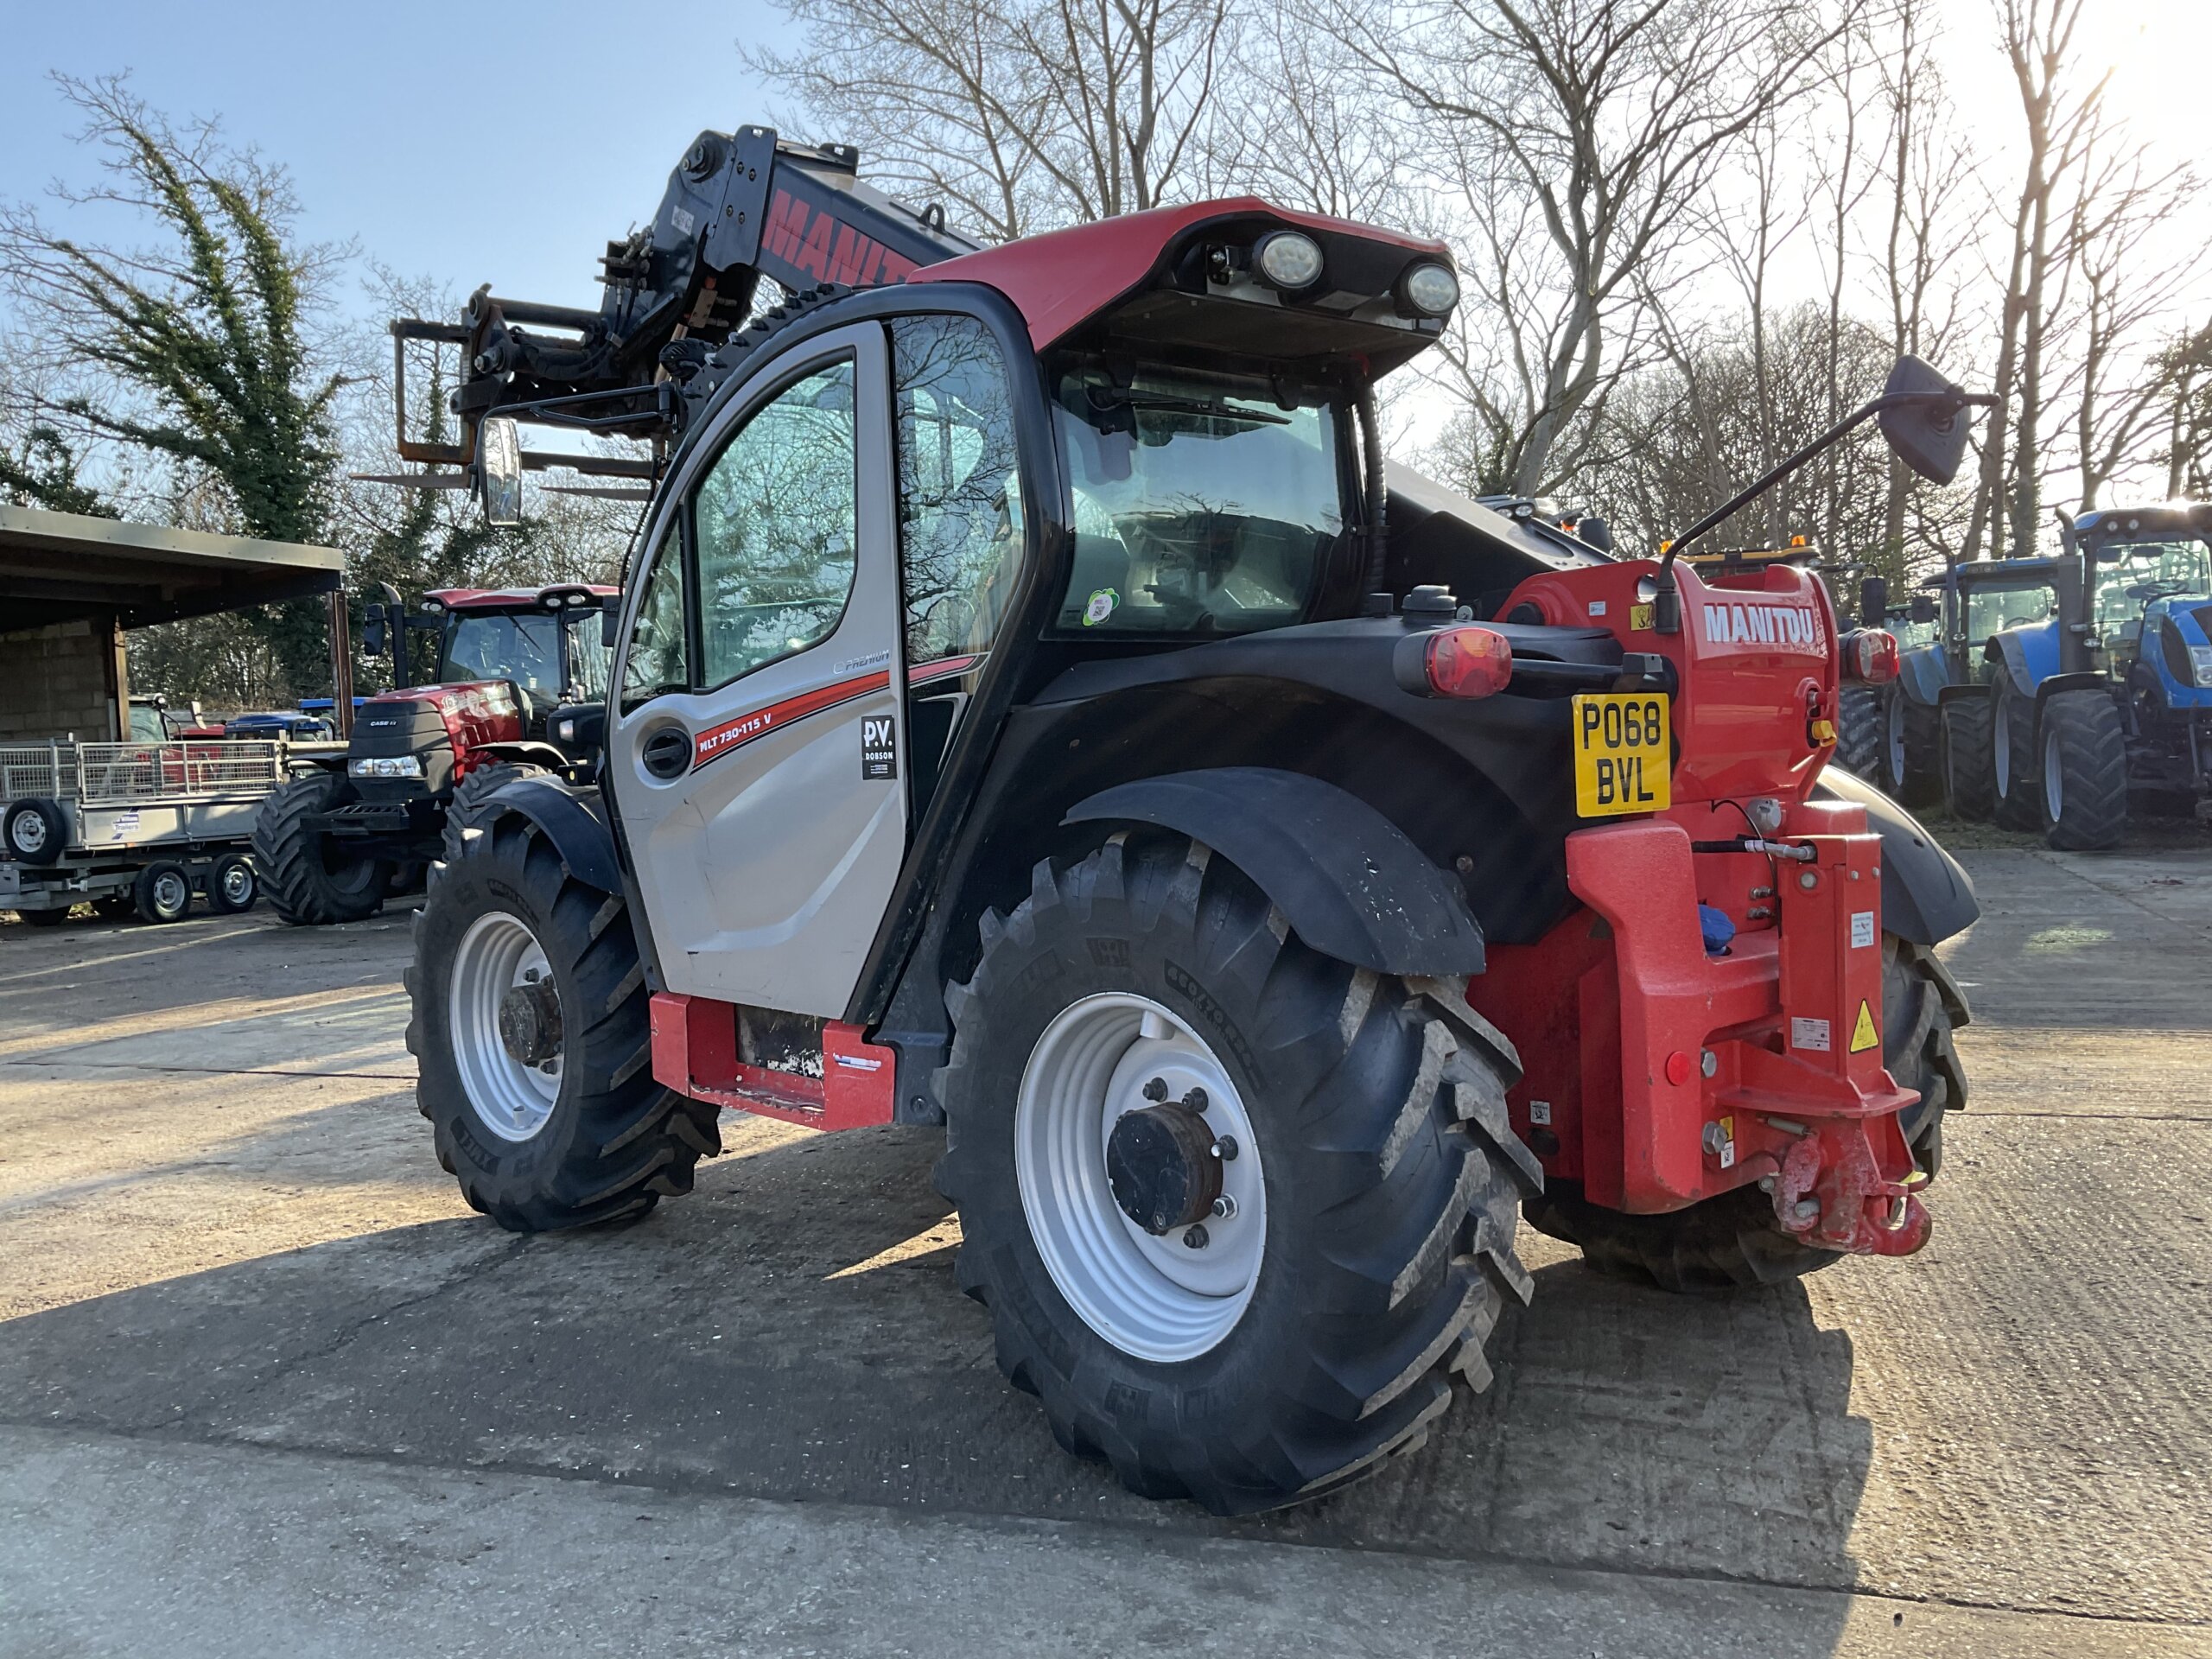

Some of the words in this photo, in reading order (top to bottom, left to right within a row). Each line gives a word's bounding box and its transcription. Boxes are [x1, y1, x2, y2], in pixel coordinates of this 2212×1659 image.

[1703, 604, 1814, 644] MANITOU
[845, 649, 889, 671] PREMIUM
[700, 736, 718, 753] MLT
[719, 718, 760, 744] 730-115
[763, 713, 772, 725] V
[864, 720, 893, 747] P.V.
[1583, 701, 1661, 750] PO68
[865, 752, 893, 760] DOBSON
[1596, 756, 1654, 804] BVL
